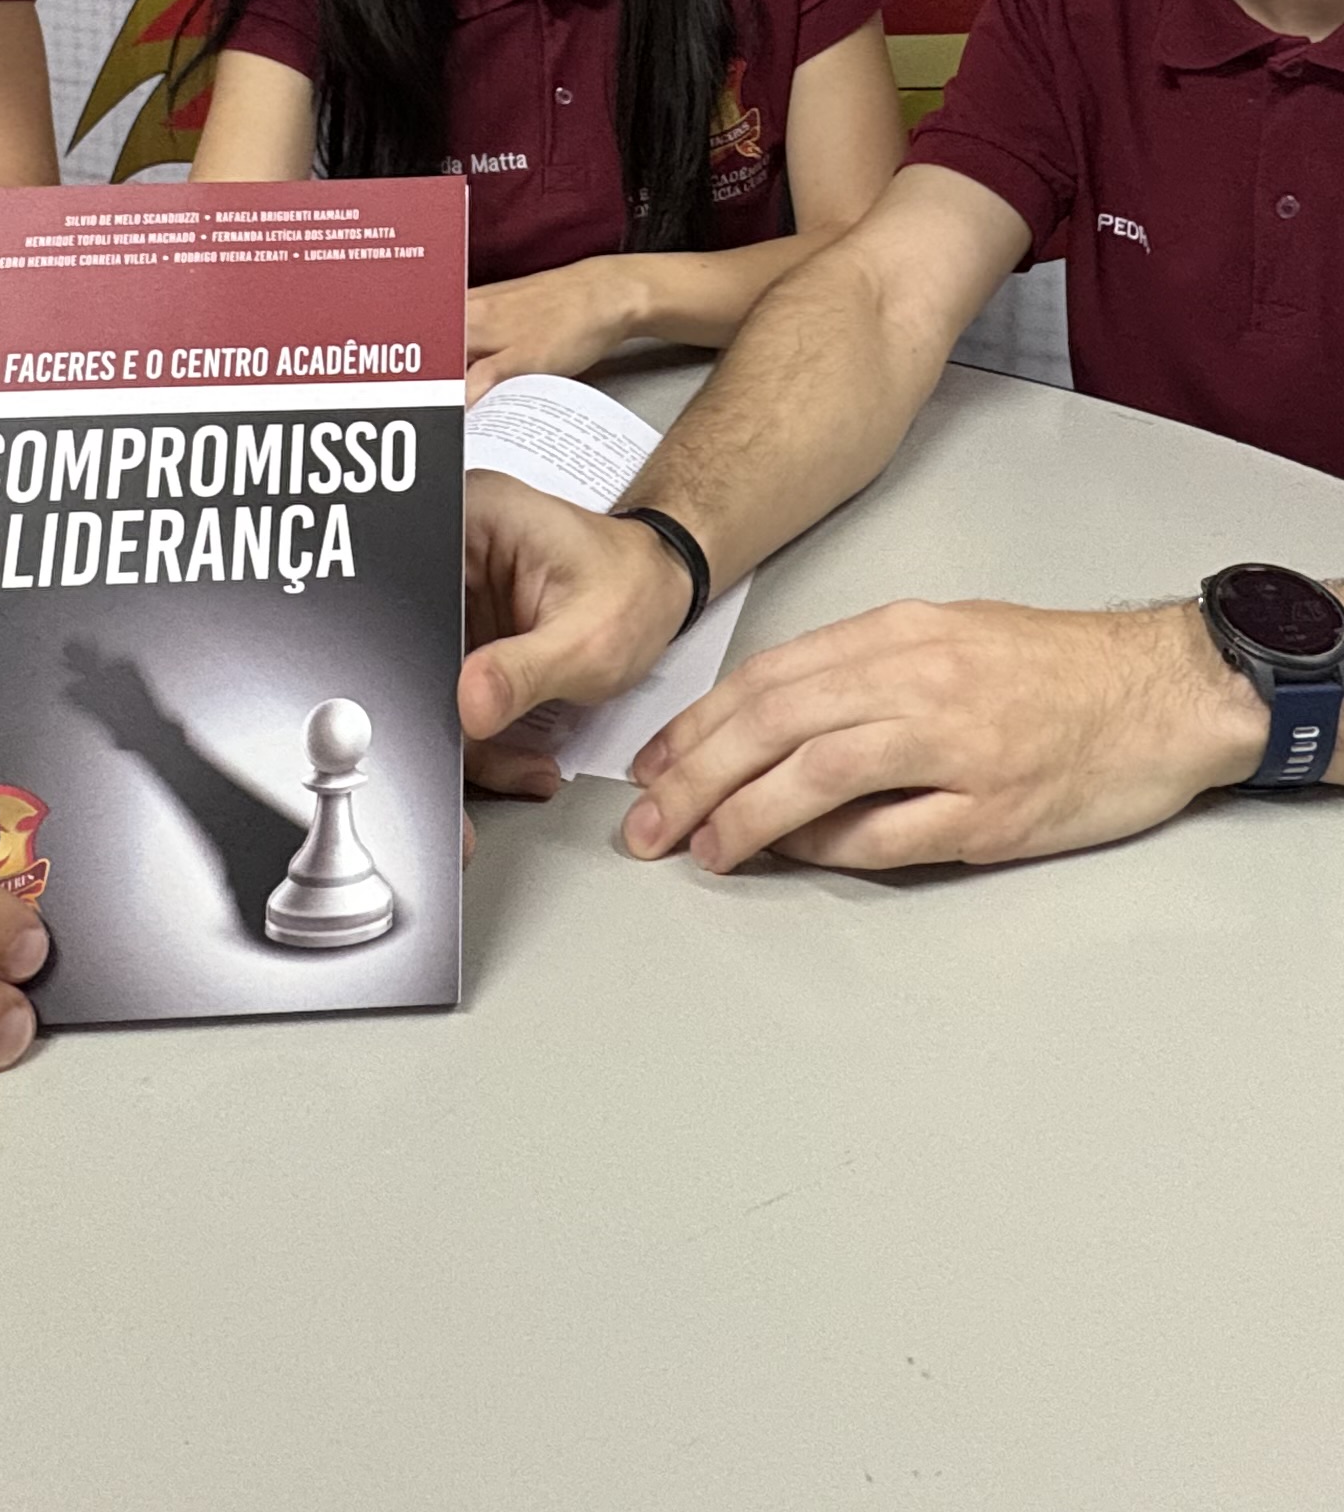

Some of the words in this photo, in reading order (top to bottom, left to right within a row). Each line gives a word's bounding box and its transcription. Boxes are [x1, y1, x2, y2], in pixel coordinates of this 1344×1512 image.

[470, 152, 528, 175] Matta
[64, 214, 98, 227] SILVIO
[98, 214, 112, 226] DE
[114, 213, 141, 226] MELO
[215, 211, 259, 223] RAFAELA
[313, 209, 360, 221] RAMALHO
[24, 234, 76, 248] HENRIQUE
[113, 232, 146, 245] VIEIRA
[147, 231, 196, 244] MACHADO
[211, 230, 264, 243] FERNANDA
[265, 228, 303, 242] LETÍCIA
[304, 229, 324, 241] DOS
[324, 227, 362, 240] SANTOS
[363, 226, 396, 239] MATTA
[27, 254, 78, 268] HENRIQUE
[78, 253, 122, 266] CORREIA
[123, 252, 158, 265] VILELA
[173, 251, 218, 264] RODRIGO
[219, 250, 253, 263] VIEIRA
[253, 249, 289, 262] ZERATI
[303, 248, 346, 261] LUCIANA
[347, 247, 392, 260] VENTURA
[3, 350, 116, 384] FACERES
[122, 349, 139, 380] E
[145, 349, 163, 380] O
[170, 346, 269, 379] CENTRO
[276, 339, 422, 376] ACADÊMICO
[1, 503, 356, 595] LIDERANÇA
